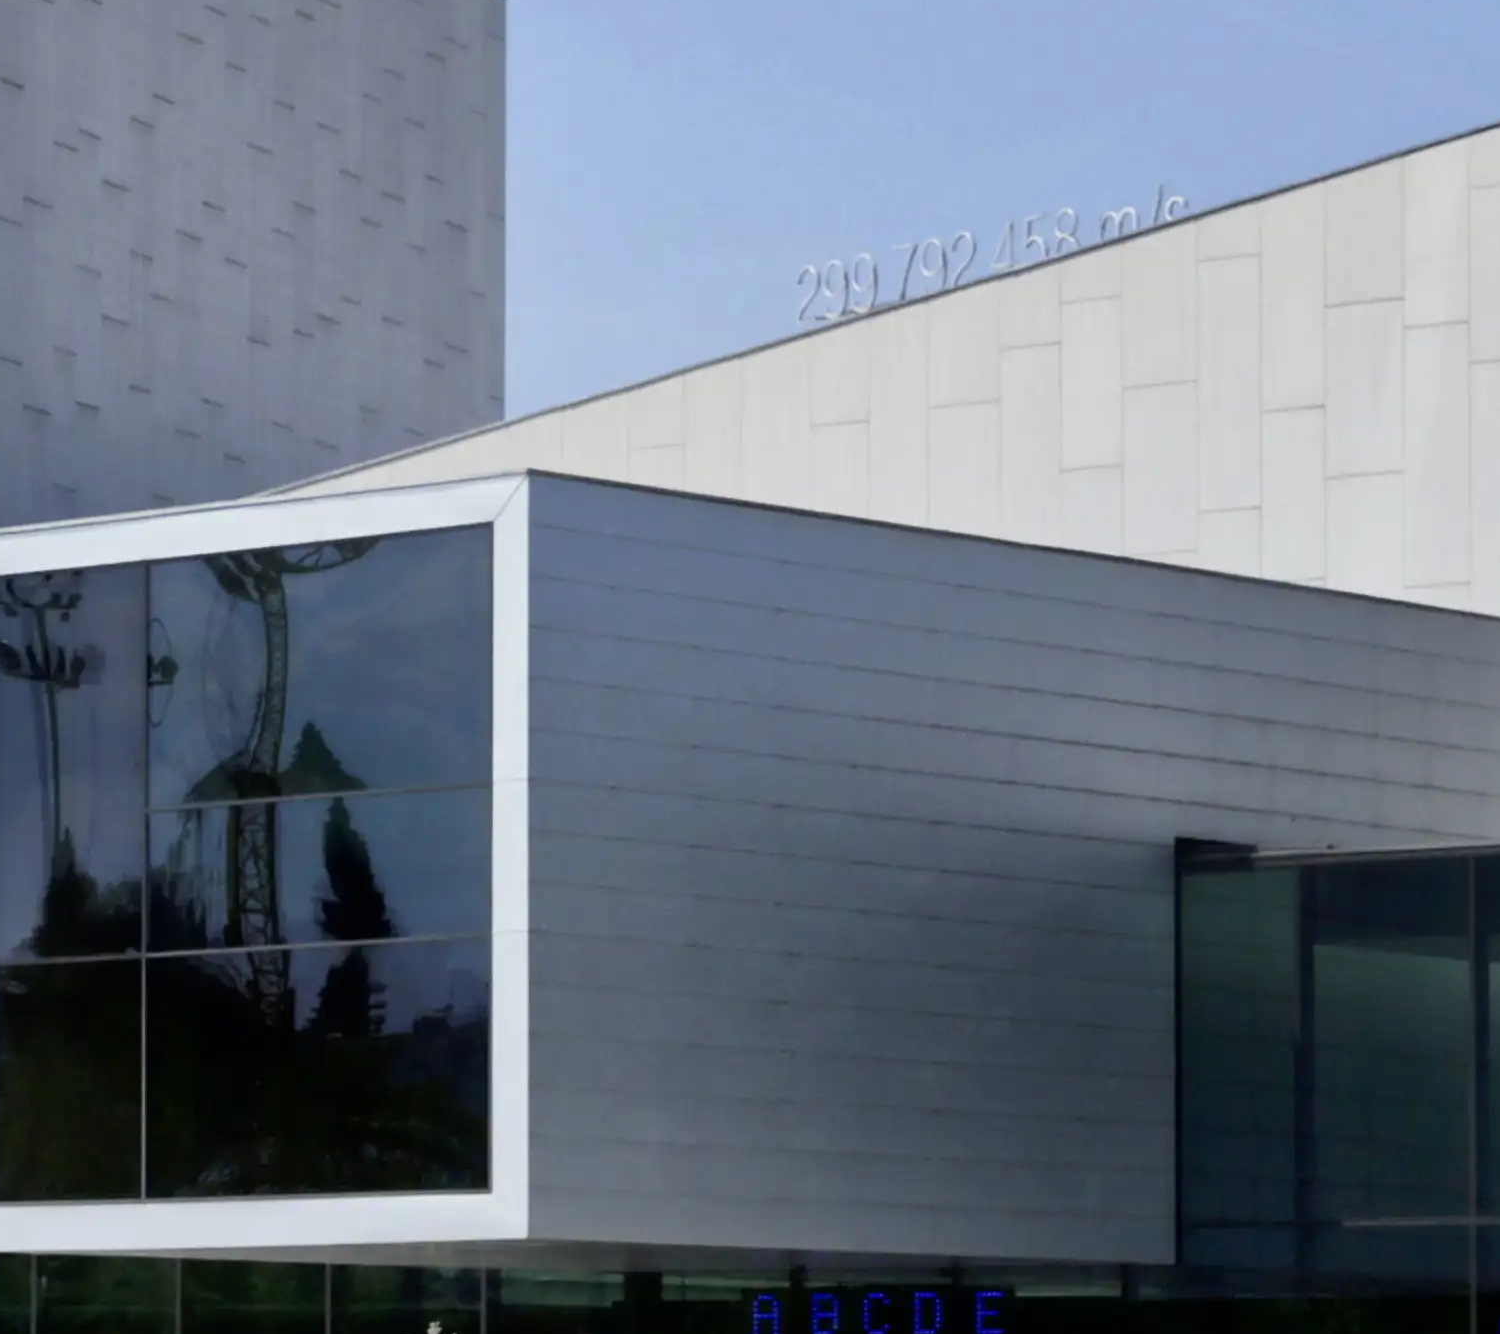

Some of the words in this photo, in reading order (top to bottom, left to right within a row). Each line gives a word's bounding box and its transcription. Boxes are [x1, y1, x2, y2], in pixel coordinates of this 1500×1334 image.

[797, 252, 880, 321] 299
[893, 231, 977, 302] 792
[991, 207, 1081, 269] 458
